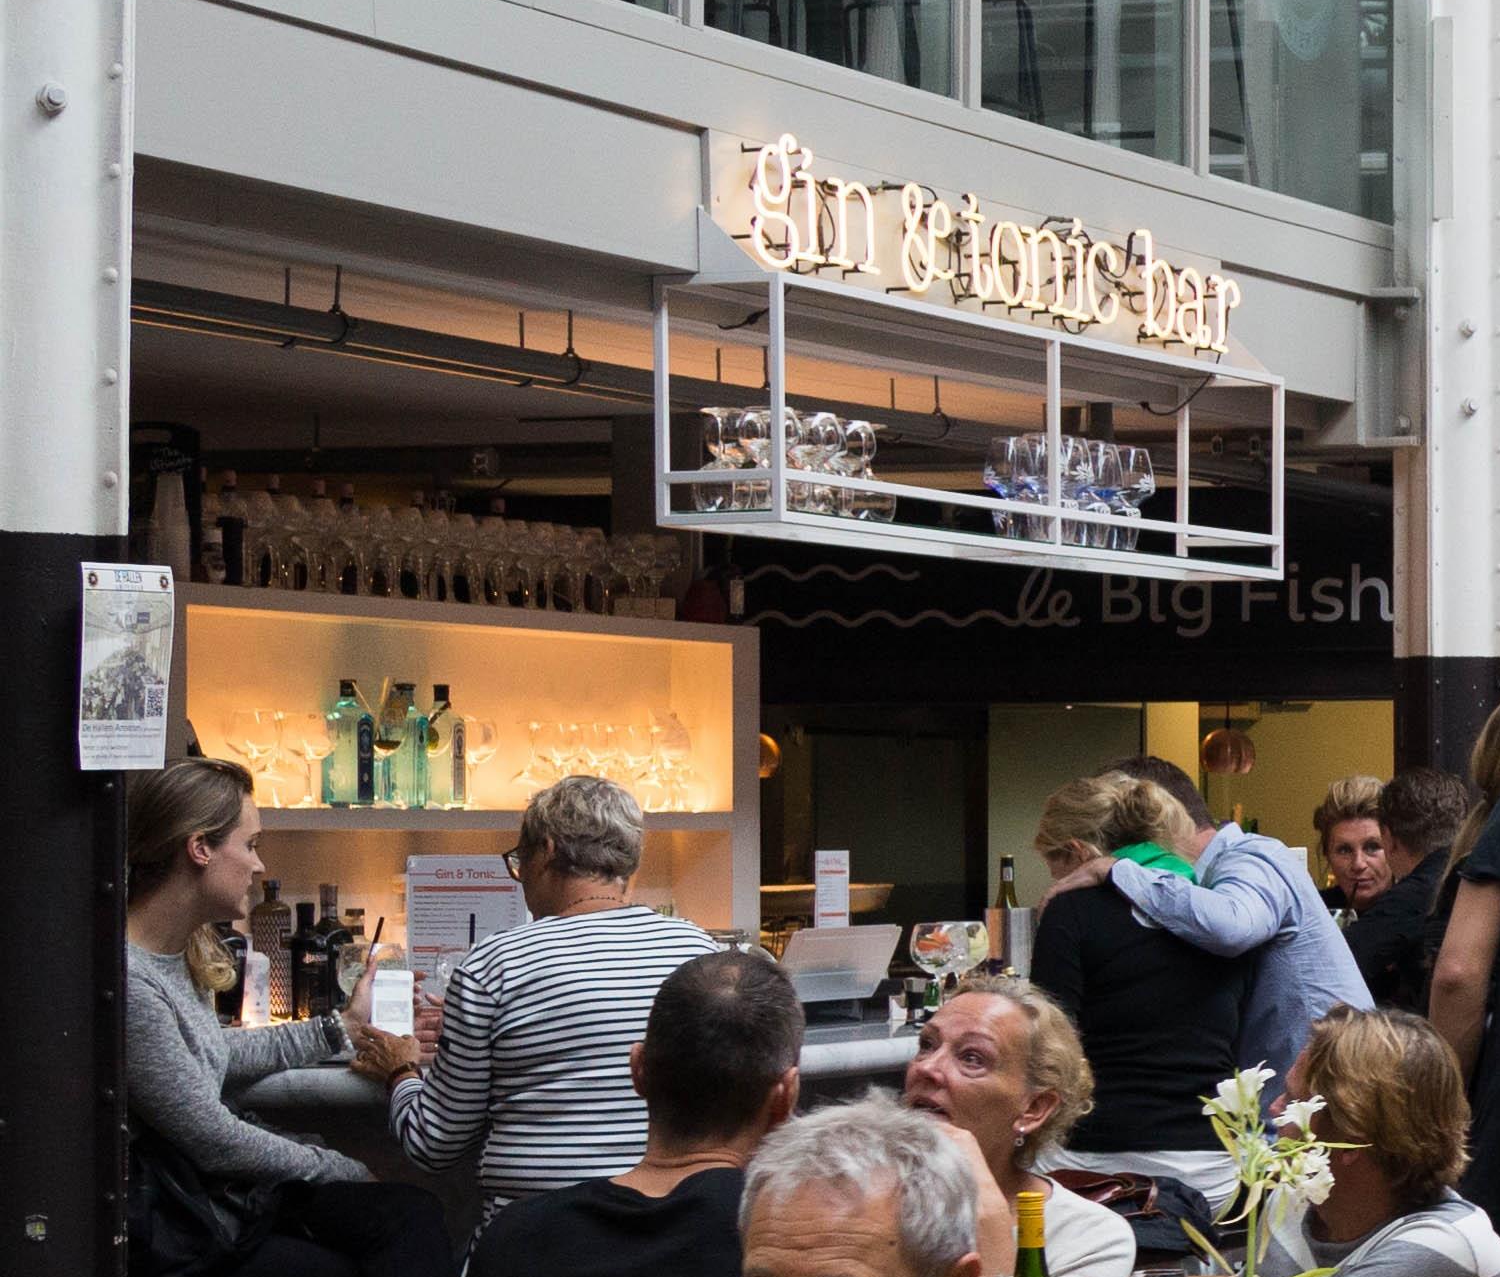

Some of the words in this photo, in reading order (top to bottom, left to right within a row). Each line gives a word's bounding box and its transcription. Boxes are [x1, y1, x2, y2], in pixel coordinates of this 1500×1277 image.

[901, 181, 954, 294] &
[961, 192, 1121, 325] tonic
[1127, 227, 1242, 355] bar
[1239, 561, 1394, 624] Fish
[435, 868, 455, 880] Gin
[466, 868, 497, 880] Tonic
